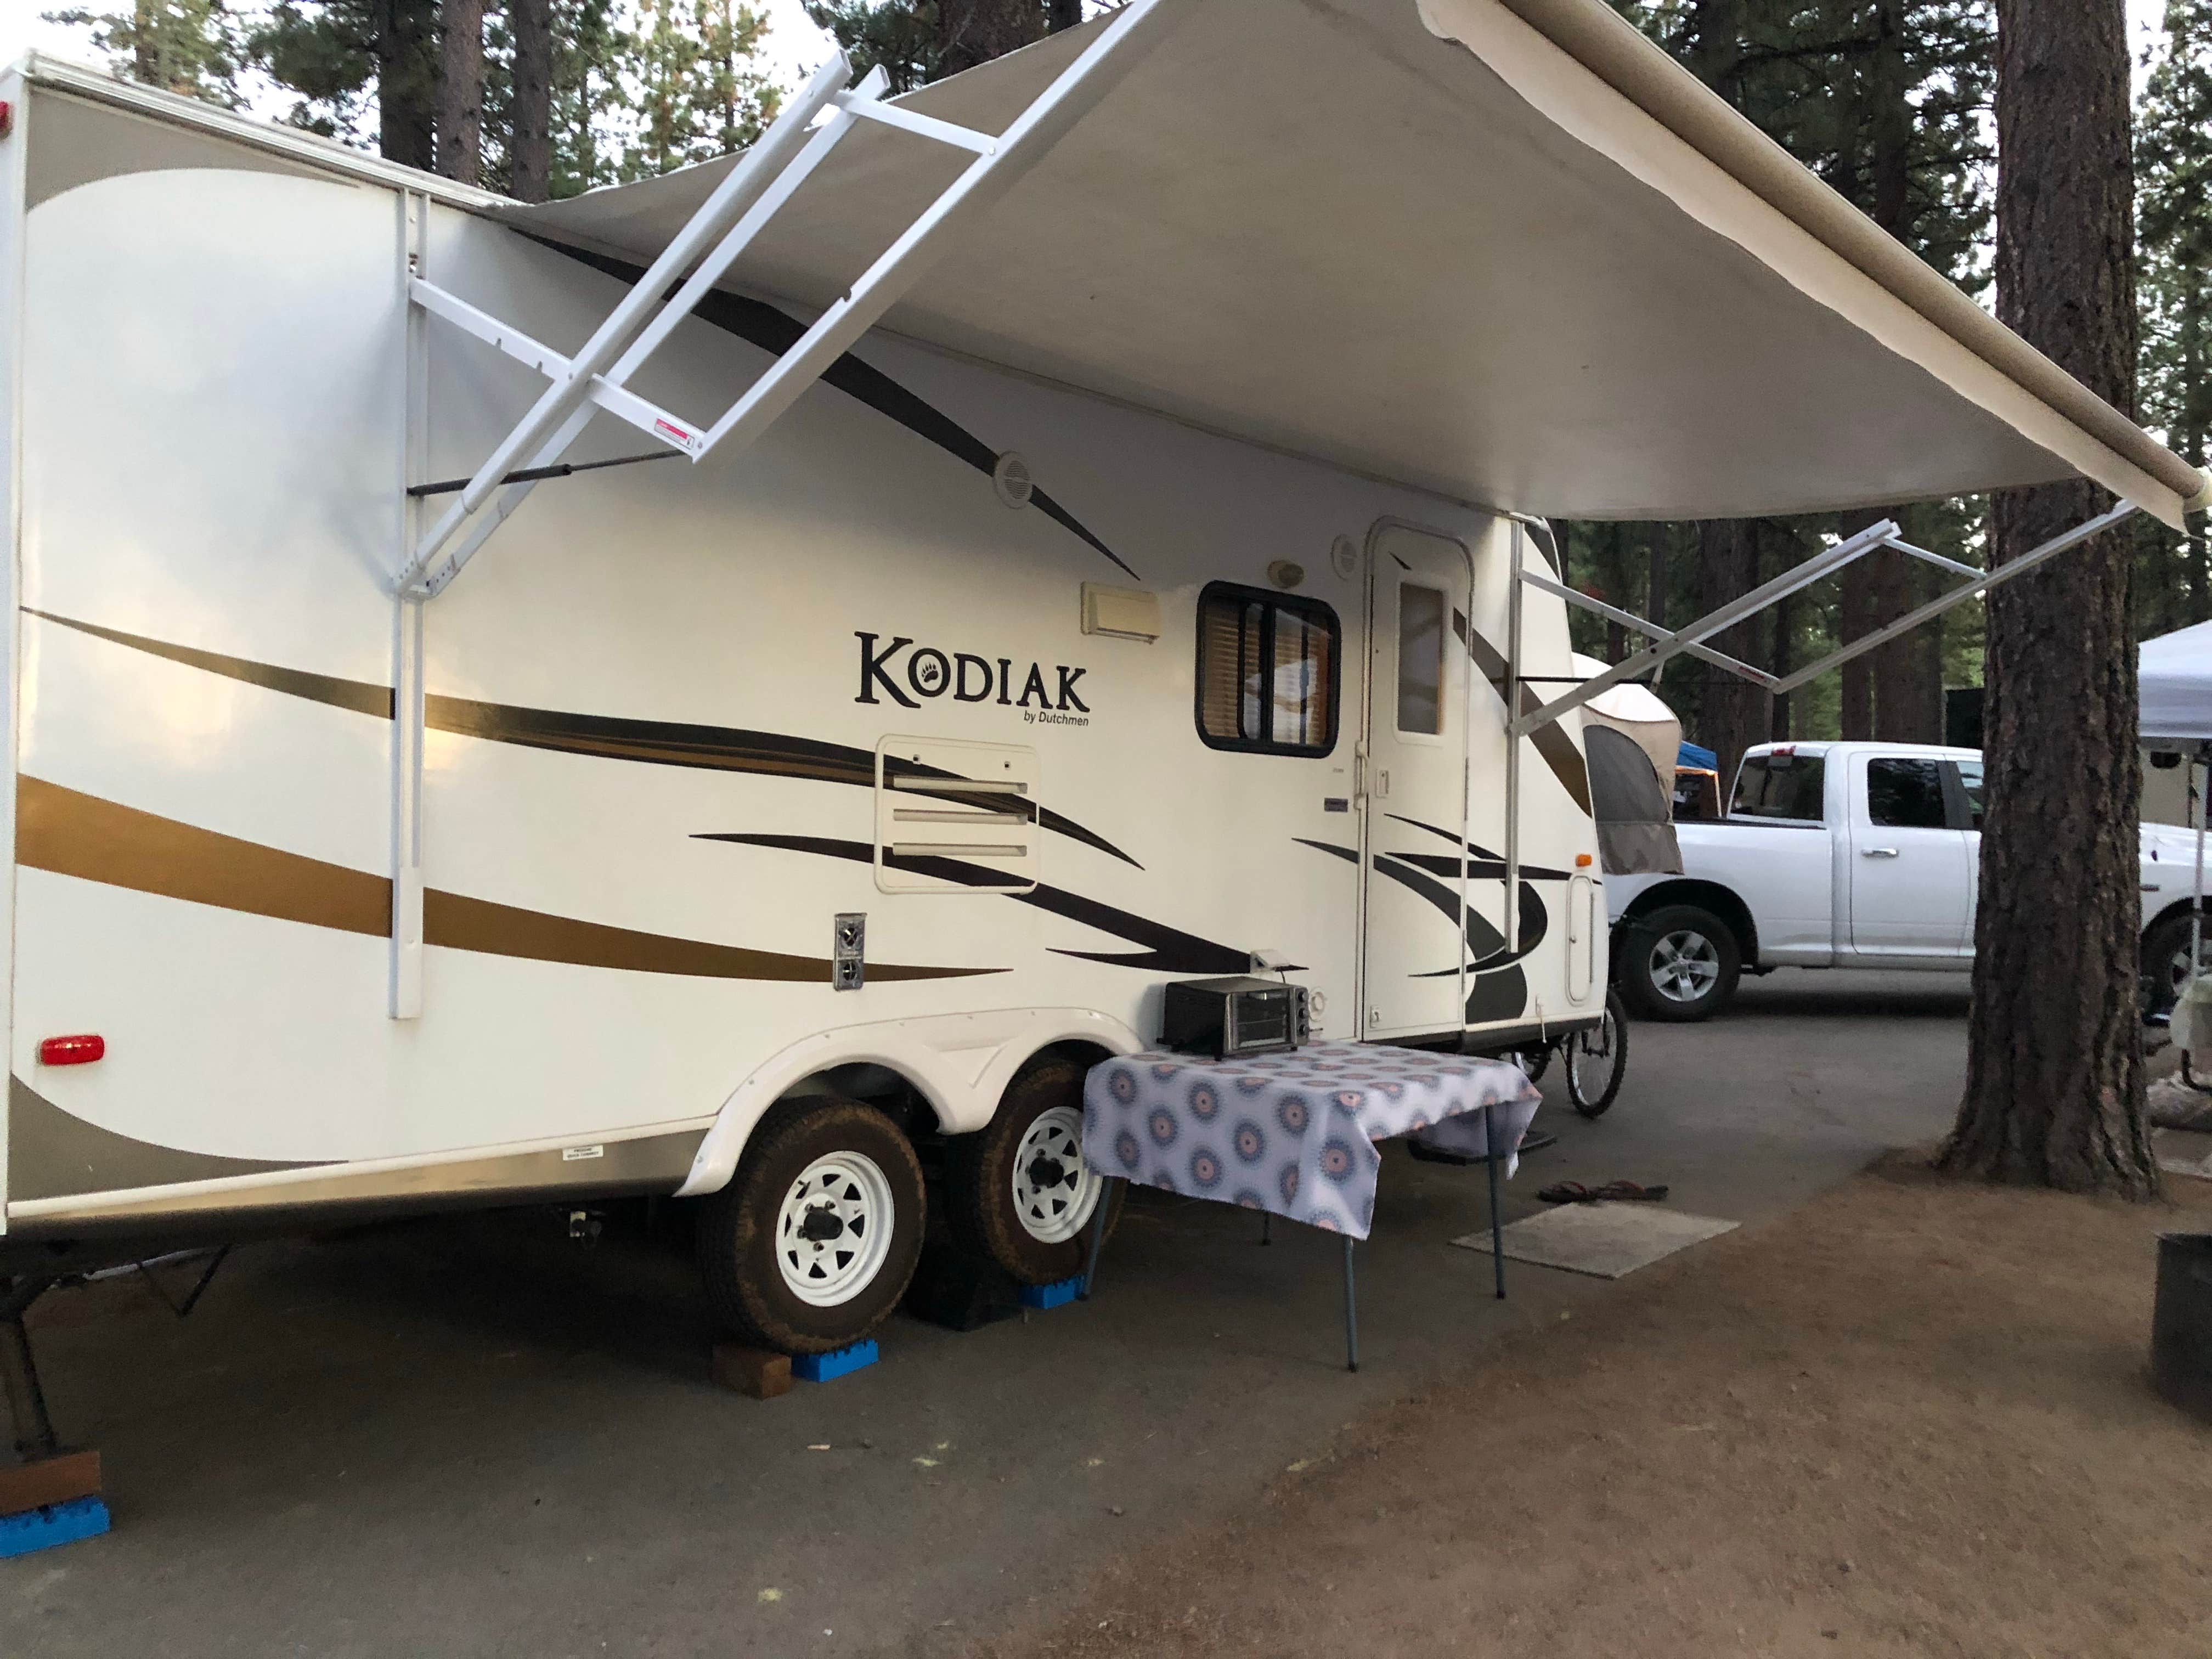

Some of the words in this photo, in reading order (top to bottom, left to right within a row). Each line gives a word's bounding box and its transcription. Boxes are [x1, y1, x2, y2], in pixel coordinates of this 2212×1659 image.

[854, 631, 1091, 713] KODIAK
[1024, 710, 1036, 724] by
[1039, 711, 1089, 727] Dutchmen
